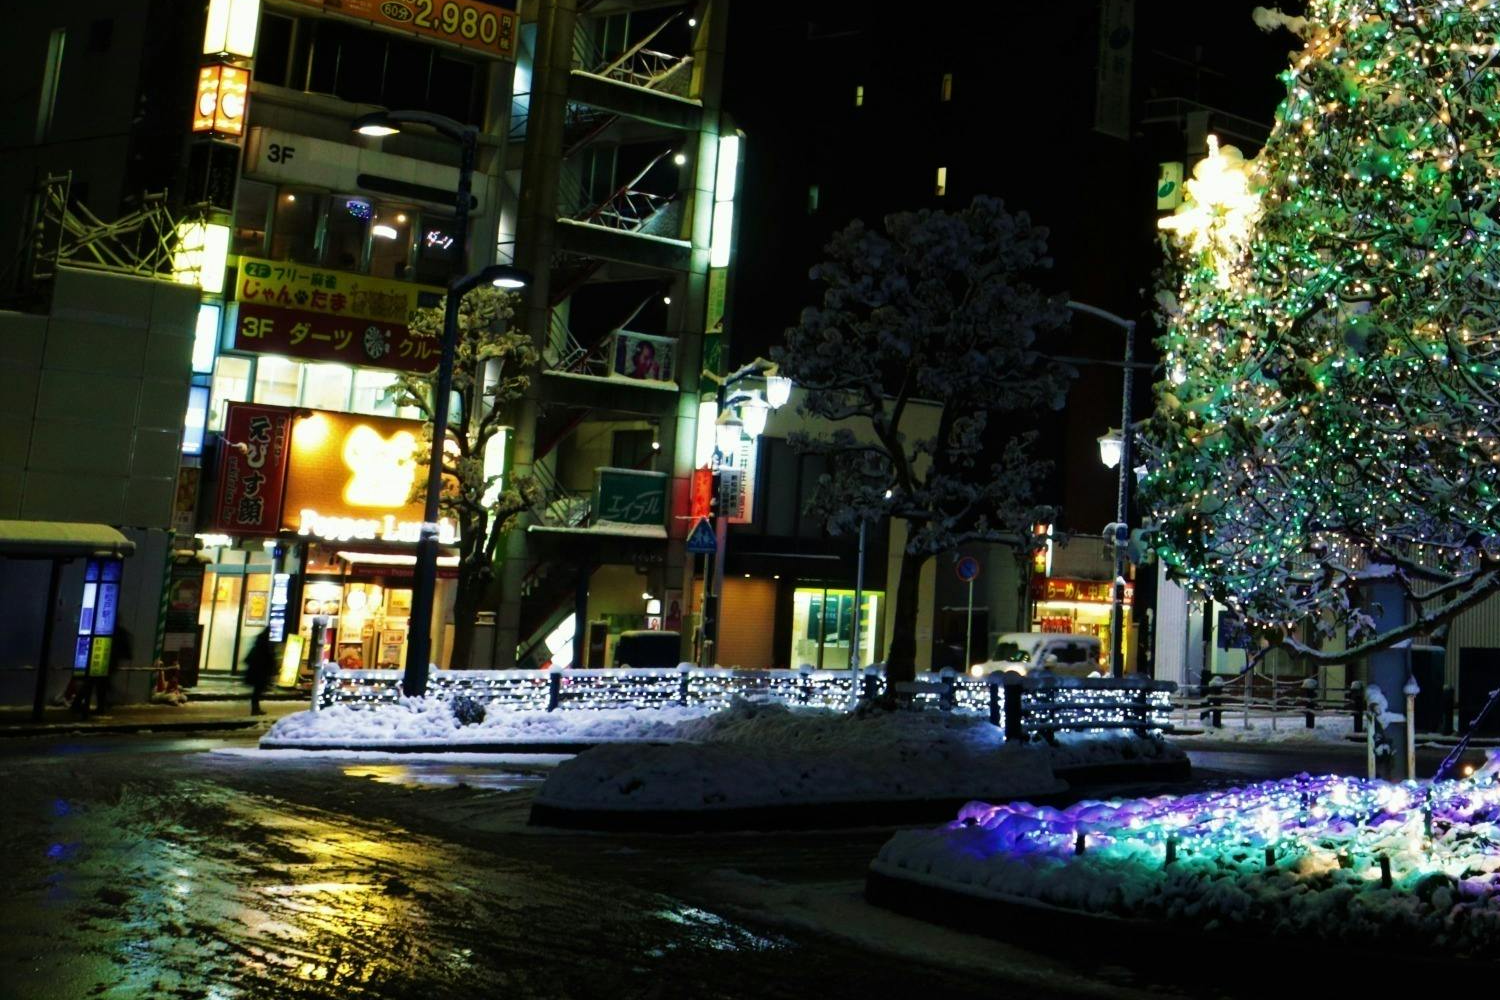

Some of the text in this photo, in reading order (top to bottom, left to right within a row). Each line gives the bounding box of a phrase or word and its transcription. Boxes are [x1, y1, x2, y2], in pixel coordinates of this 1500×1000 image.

[267, 143, 295, 165] 3F
[274, 268, 338, 290] フリー麻雀
[242, 317, 274, 339] 3F
[289, 322, 353, 351] ダーツ
[607, 491, 662, 520] エイブル
[298, 509, 455, 544] Pepper Lunh
